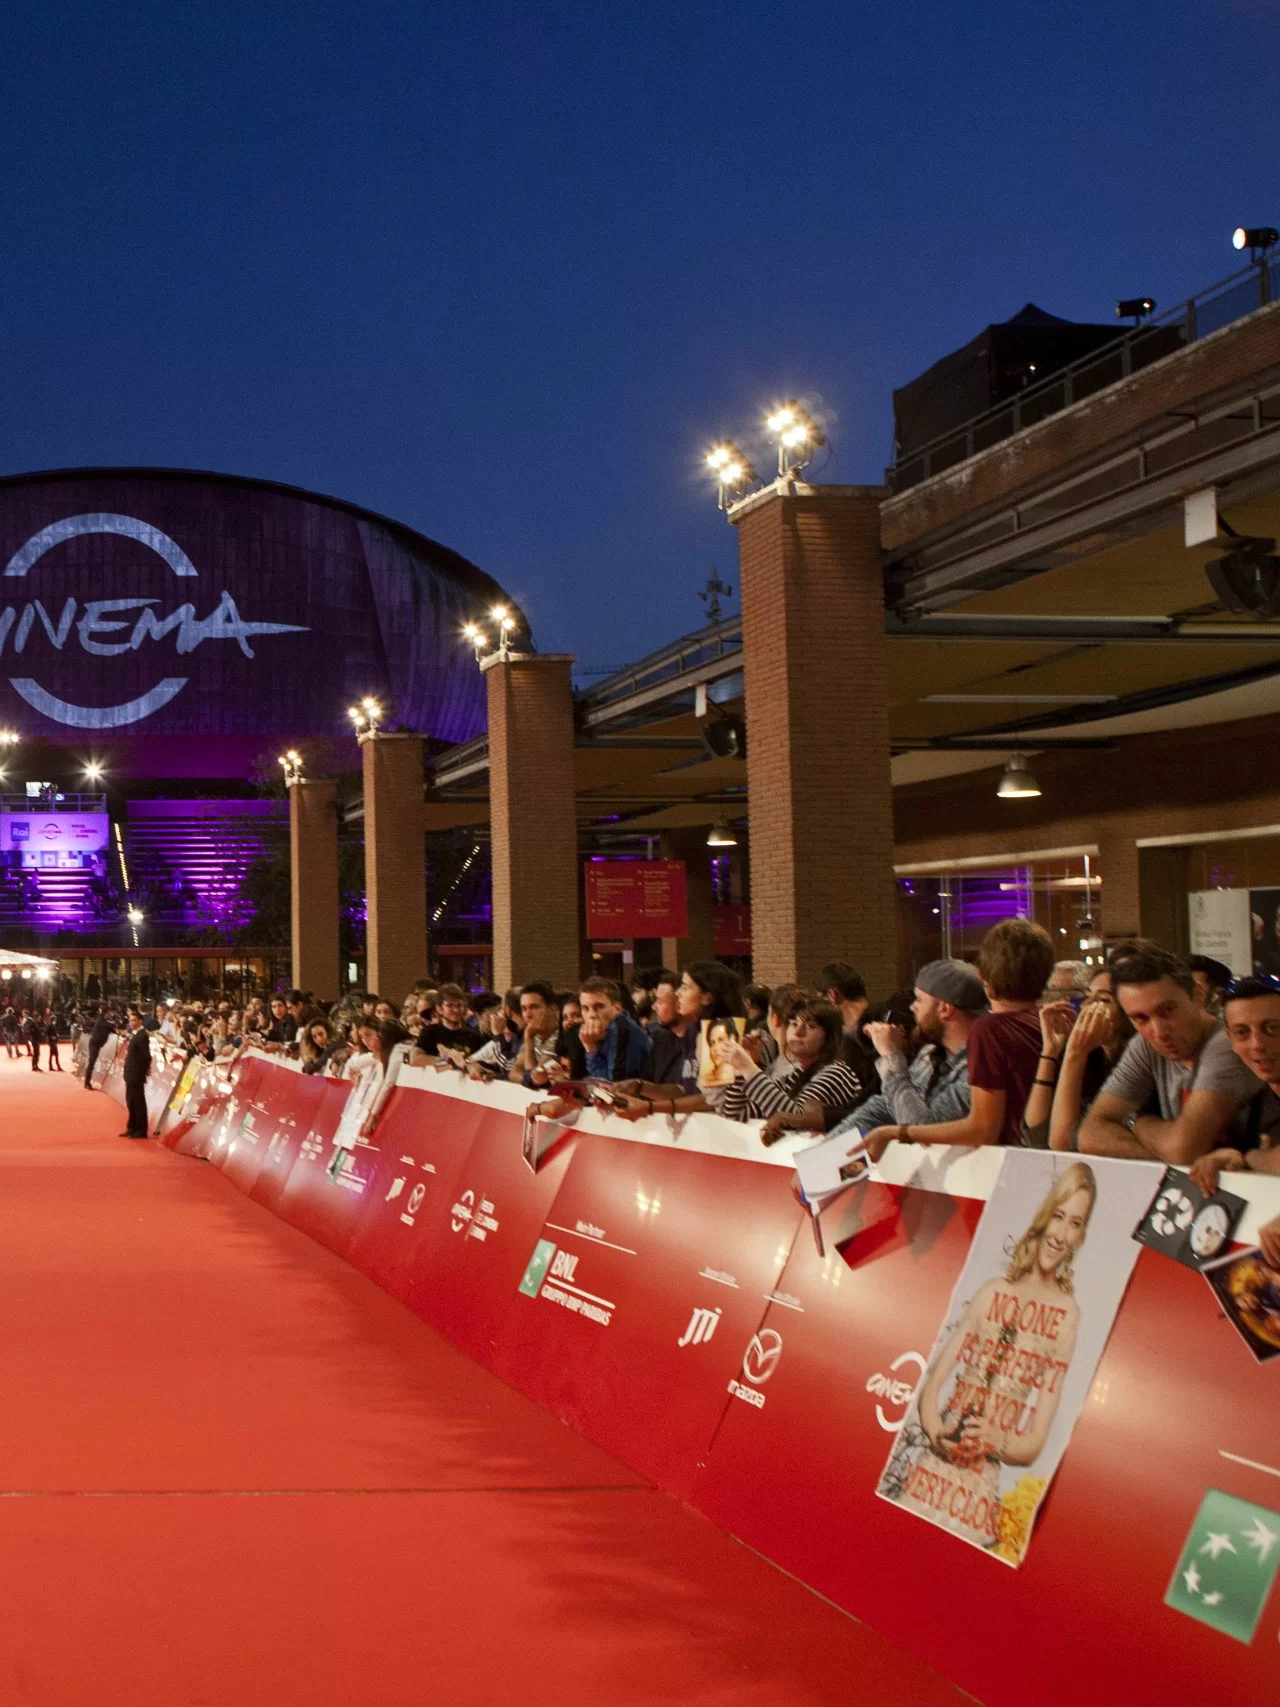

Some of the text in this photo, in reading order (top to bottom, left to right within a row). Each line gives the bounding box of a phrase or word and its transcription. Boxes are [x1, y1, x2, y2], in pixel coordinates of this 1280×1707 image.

[549, 1249, 579, 1283] BNL
[984, 1291, 1068, 1341] NO ONE
[865, 1372, 916, 1406] CINE
[987, 1391, 1037, 1438] YOU
[903, 1463, 953, 1512] VERY
